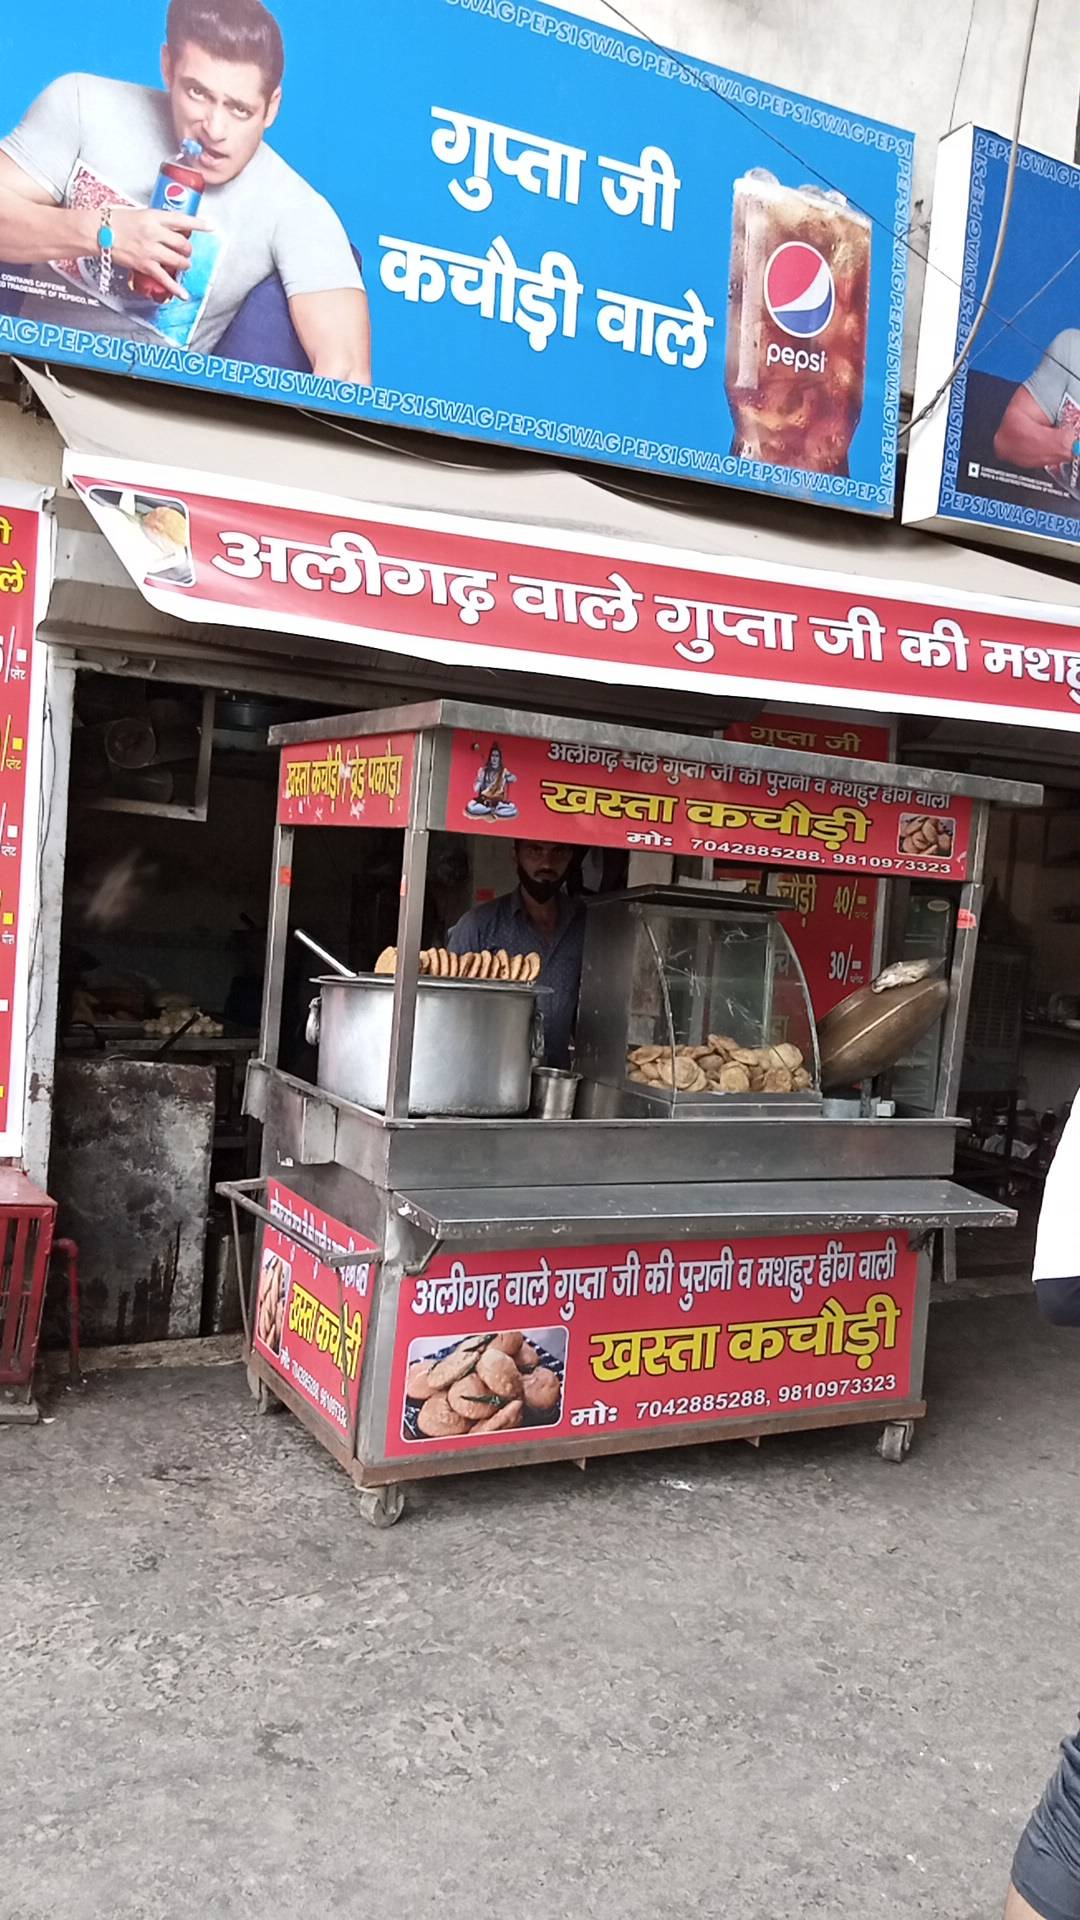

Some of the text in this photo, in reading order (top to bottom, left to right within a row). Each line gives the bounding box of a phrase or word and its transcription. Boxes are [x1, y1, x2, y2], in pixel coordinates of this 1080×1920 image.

[431, 105, 681, 232] गुप्ता जी
[7, 281, 48, 296] TRADEMARK
[48, 289, 57, 298] OF
[378, 234, 714, 370] कचौड़ी वाले
[766, 343, 827, 373] pepsi
[210, 530, 497, 625] अलीगढ़
[508, 572, 645, 633] वाले
[653, 594, 798, 663] गुप्ता
[808, 606, 887, 662] जी
[897, 618, 969, 672] की
[825, 732, 862, 752] जी
[663, 758, 706, 784] गुप्ता
[815, 778, 826, 794] व
[541, 781, 872, 850] खस्ता कचौड़ी
[691, 838, 826, 864] 7042885288,
[833, 853, 951, 874] 9810973323
[411, 1236, 897, 1321] अलीगढ़ वाले गुप्ता जी की पुरानी व मशहुर हींग वाली
[288, 1281, 319, 1344] खस्ता
[589, 1293, 900, 1382] खस्ता कचौड़ी
[636, 1388, 771, 1419] 7042885288,
[778, 1375, 896, 1403] 9810973323
